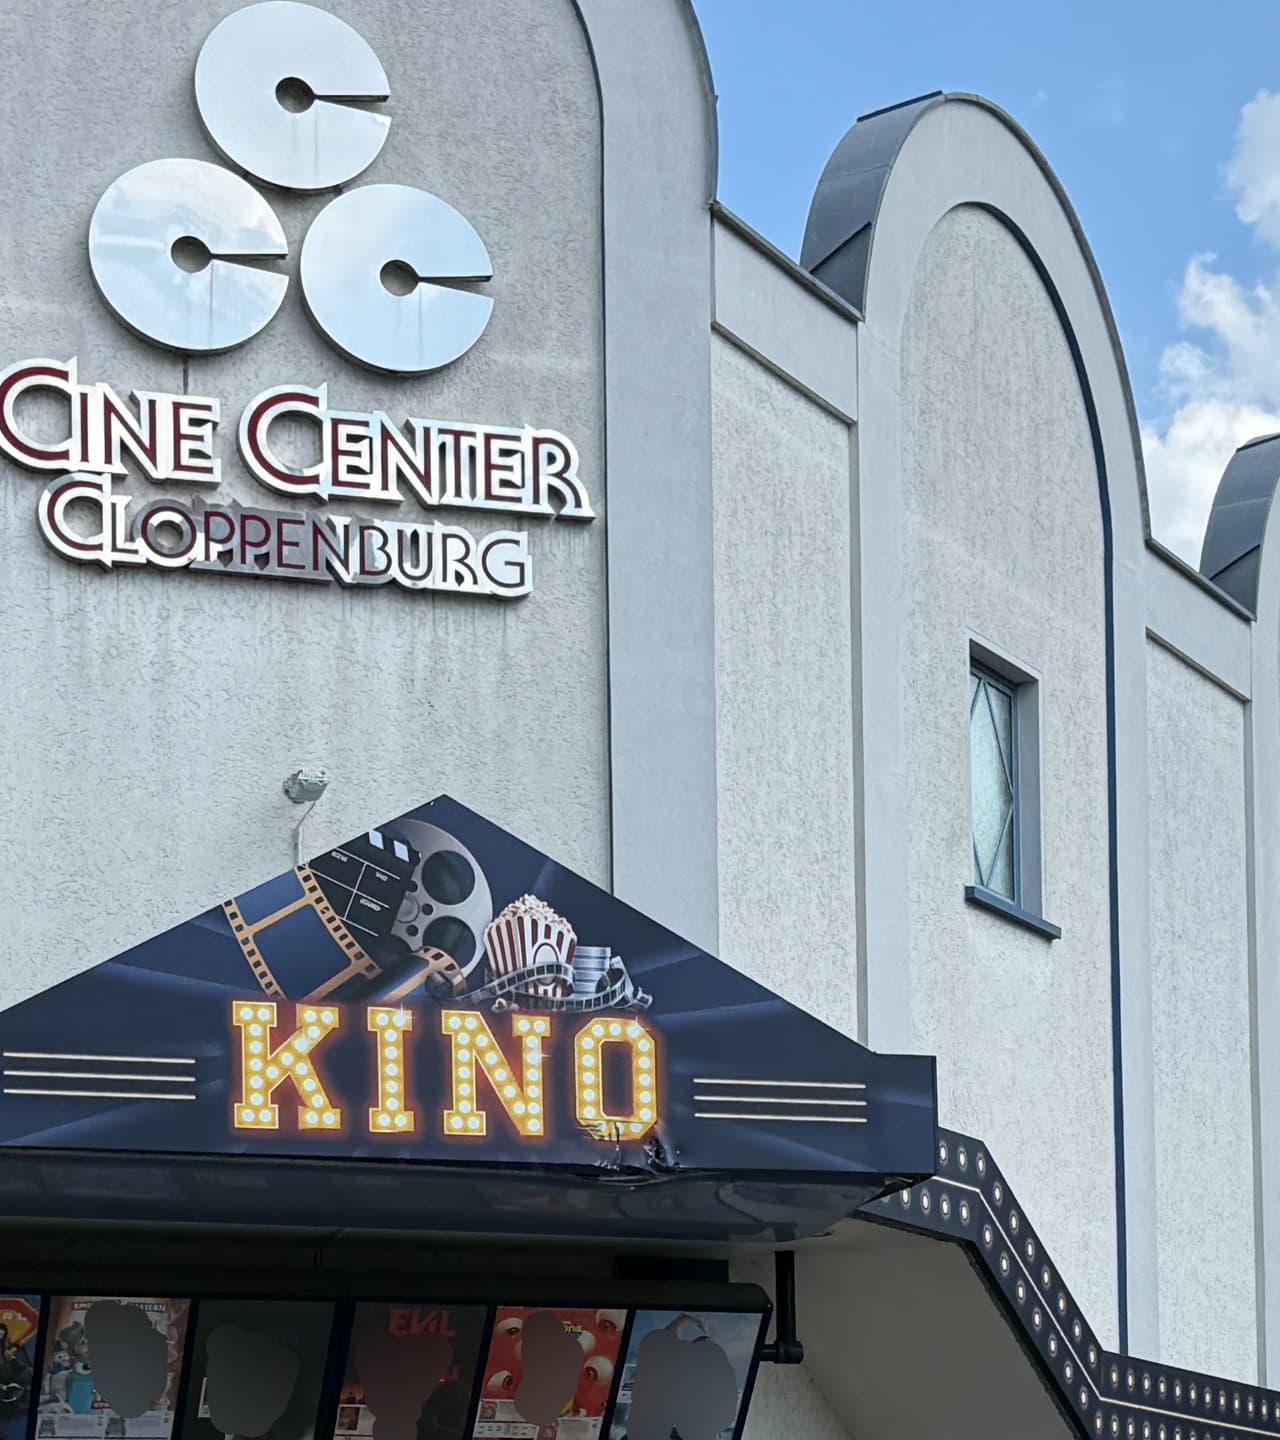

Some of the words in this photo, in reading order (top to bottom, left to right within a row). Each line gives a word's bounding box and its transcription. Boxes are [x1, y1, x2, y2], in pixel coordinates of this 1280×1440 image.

[239, 382, 596, 521] CENTER
[37, 472, 534, 600] CLOPPENBURG
[232, 1000, 658, 1142] KINO
